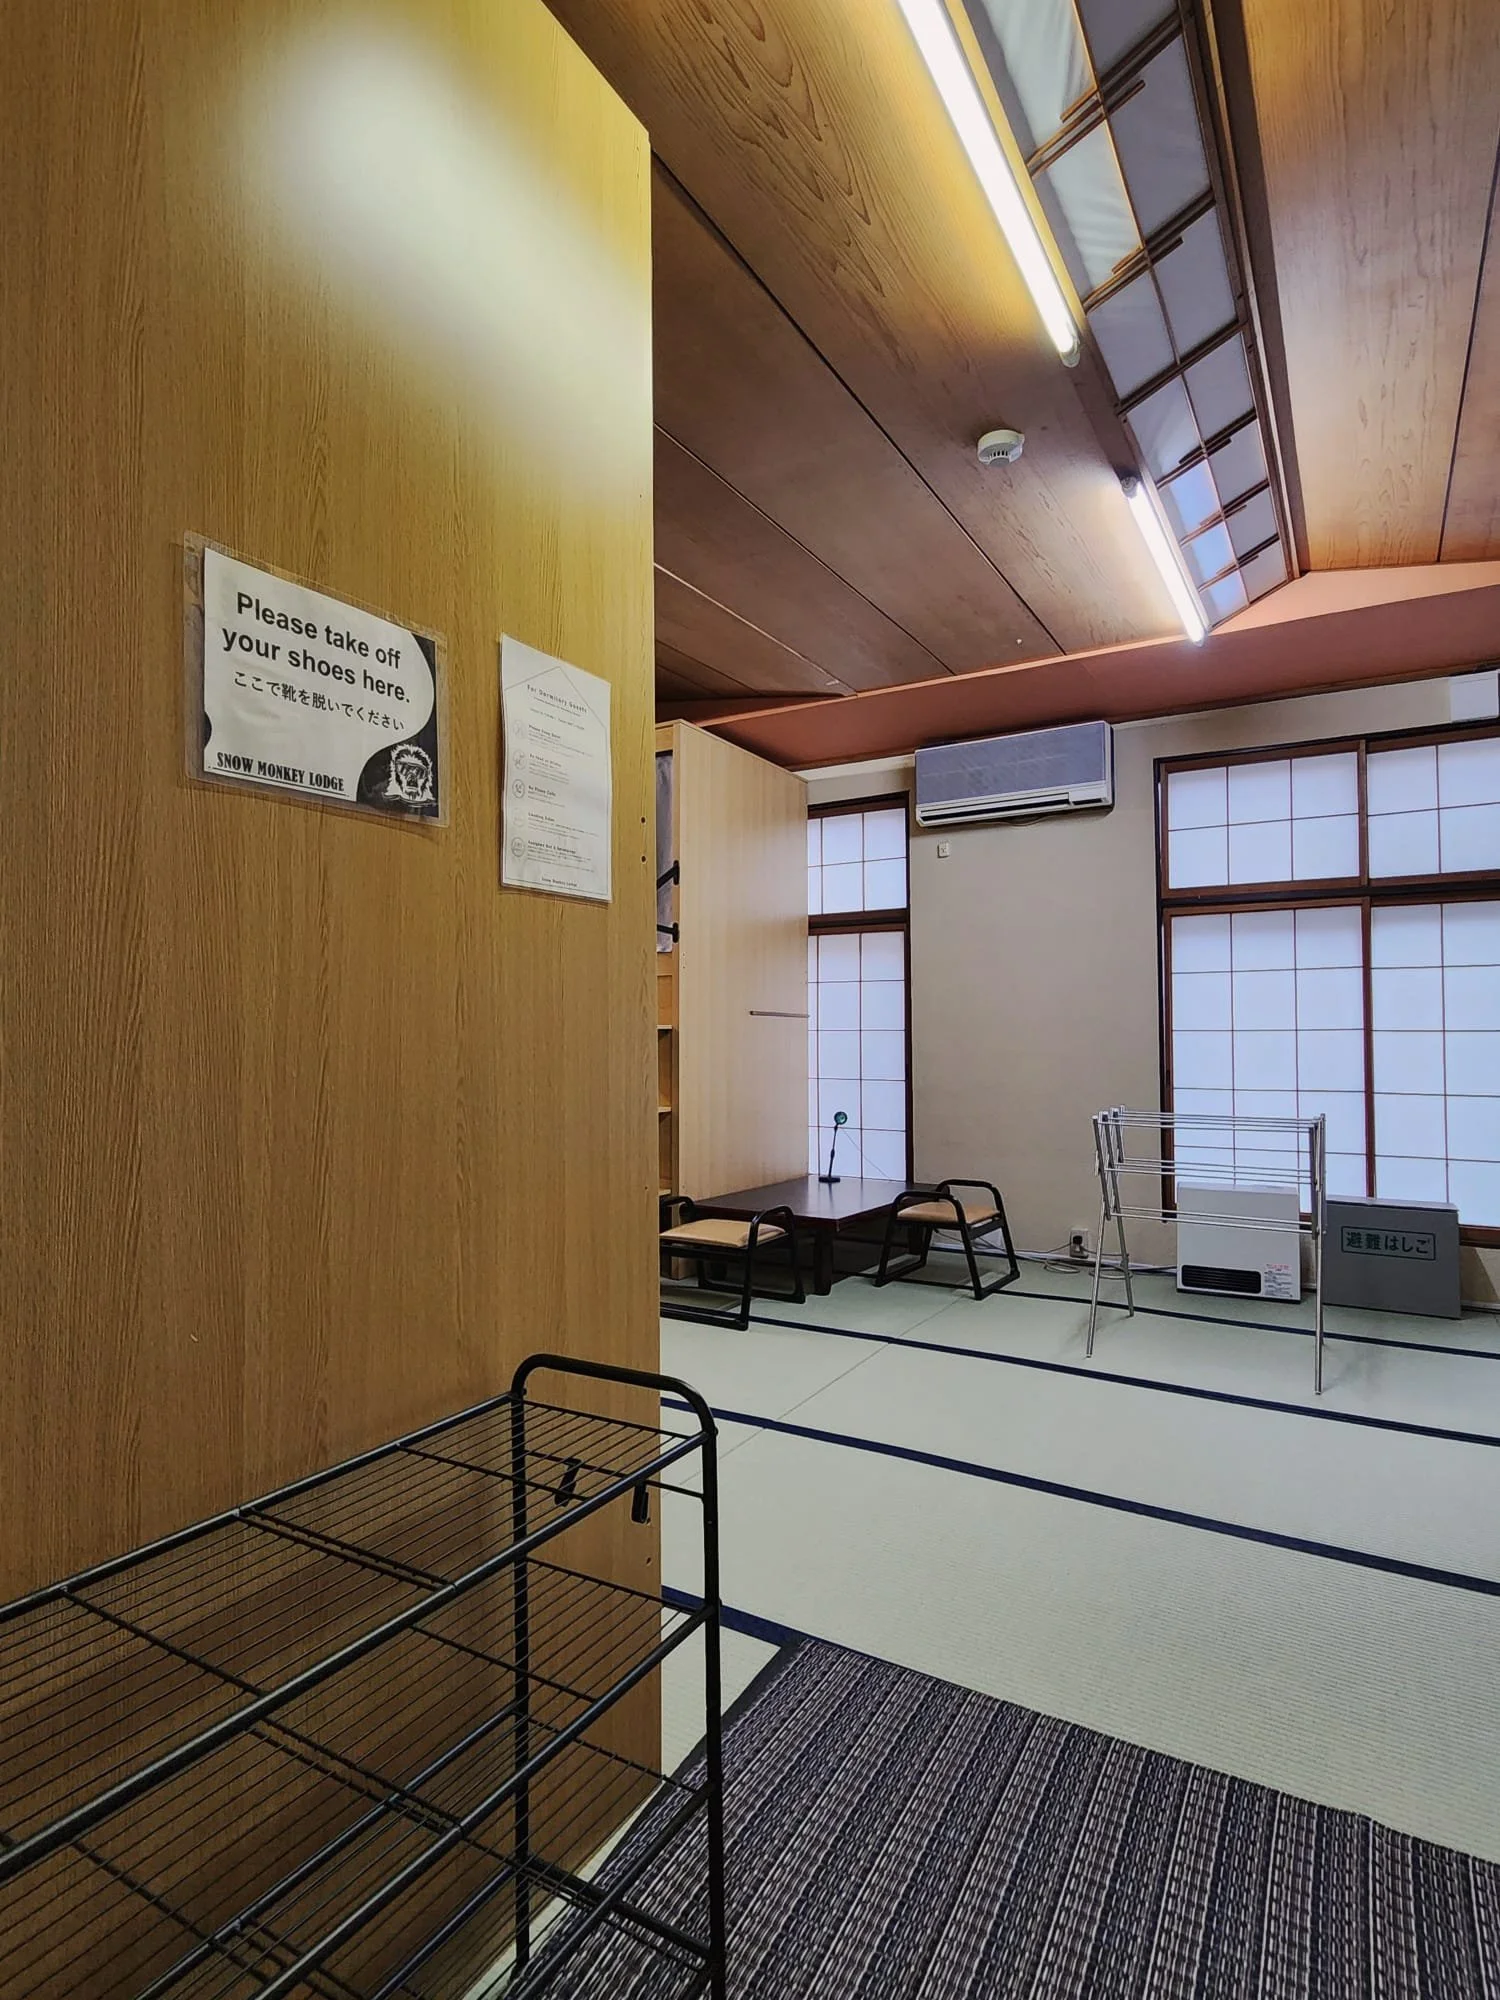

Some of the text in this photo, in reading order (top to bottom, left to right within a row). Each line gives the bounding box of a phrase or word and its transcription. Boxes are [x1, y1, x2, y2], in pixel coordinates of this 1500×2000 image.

[237, 591, 401, 670] Please take off
[222, 627, 411, 704] your shoes here.
[234, 671, 405, 731] ここで靴を脱いでください
[216, 751, 345, 791] SNOW MONKEY LODGE
[1346, 1231, 1431, 1254] 避難はしご
